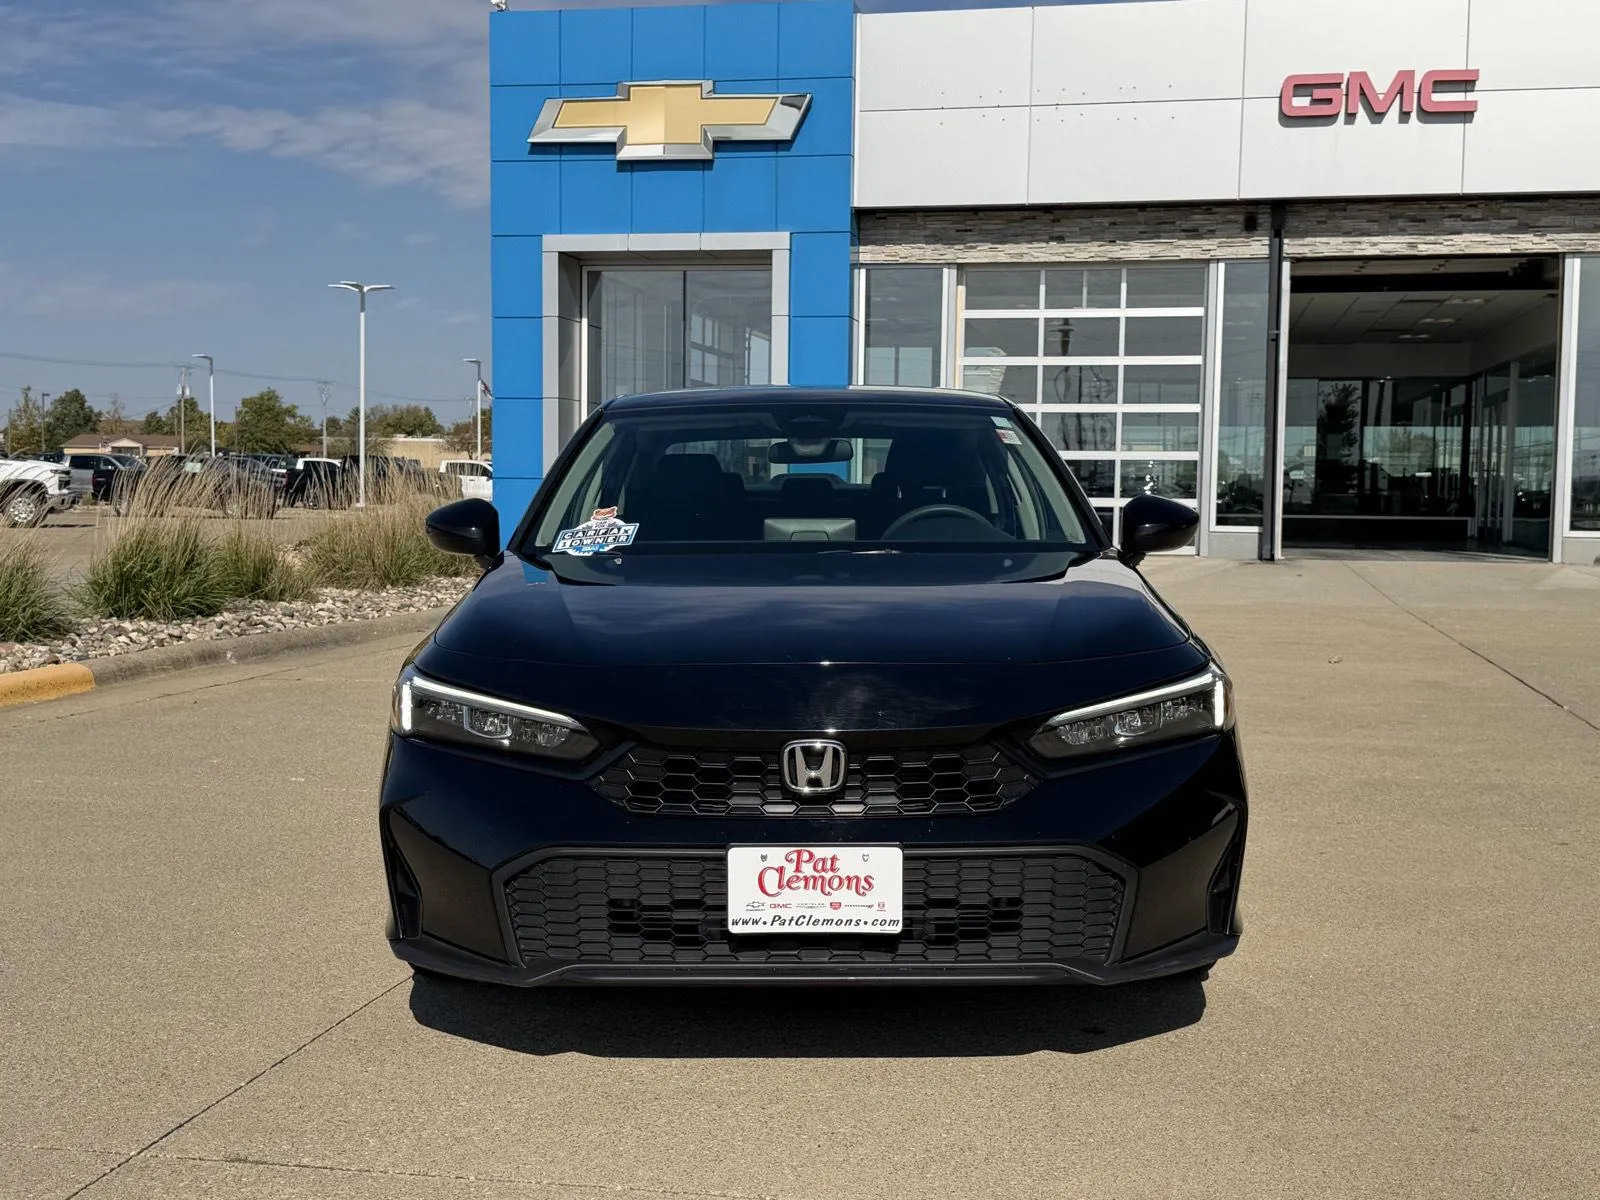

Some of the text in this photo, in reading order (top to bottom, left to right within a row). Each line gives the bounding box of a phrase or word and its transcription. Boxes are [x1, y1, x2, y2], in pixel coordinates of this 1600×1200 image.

[1281, 69, 1479, 118] GMC
[563, 527, 632, 540] CARFAX
[784, 848, 841, 874] Pat
[757, 865, 875, 898] Clemons
